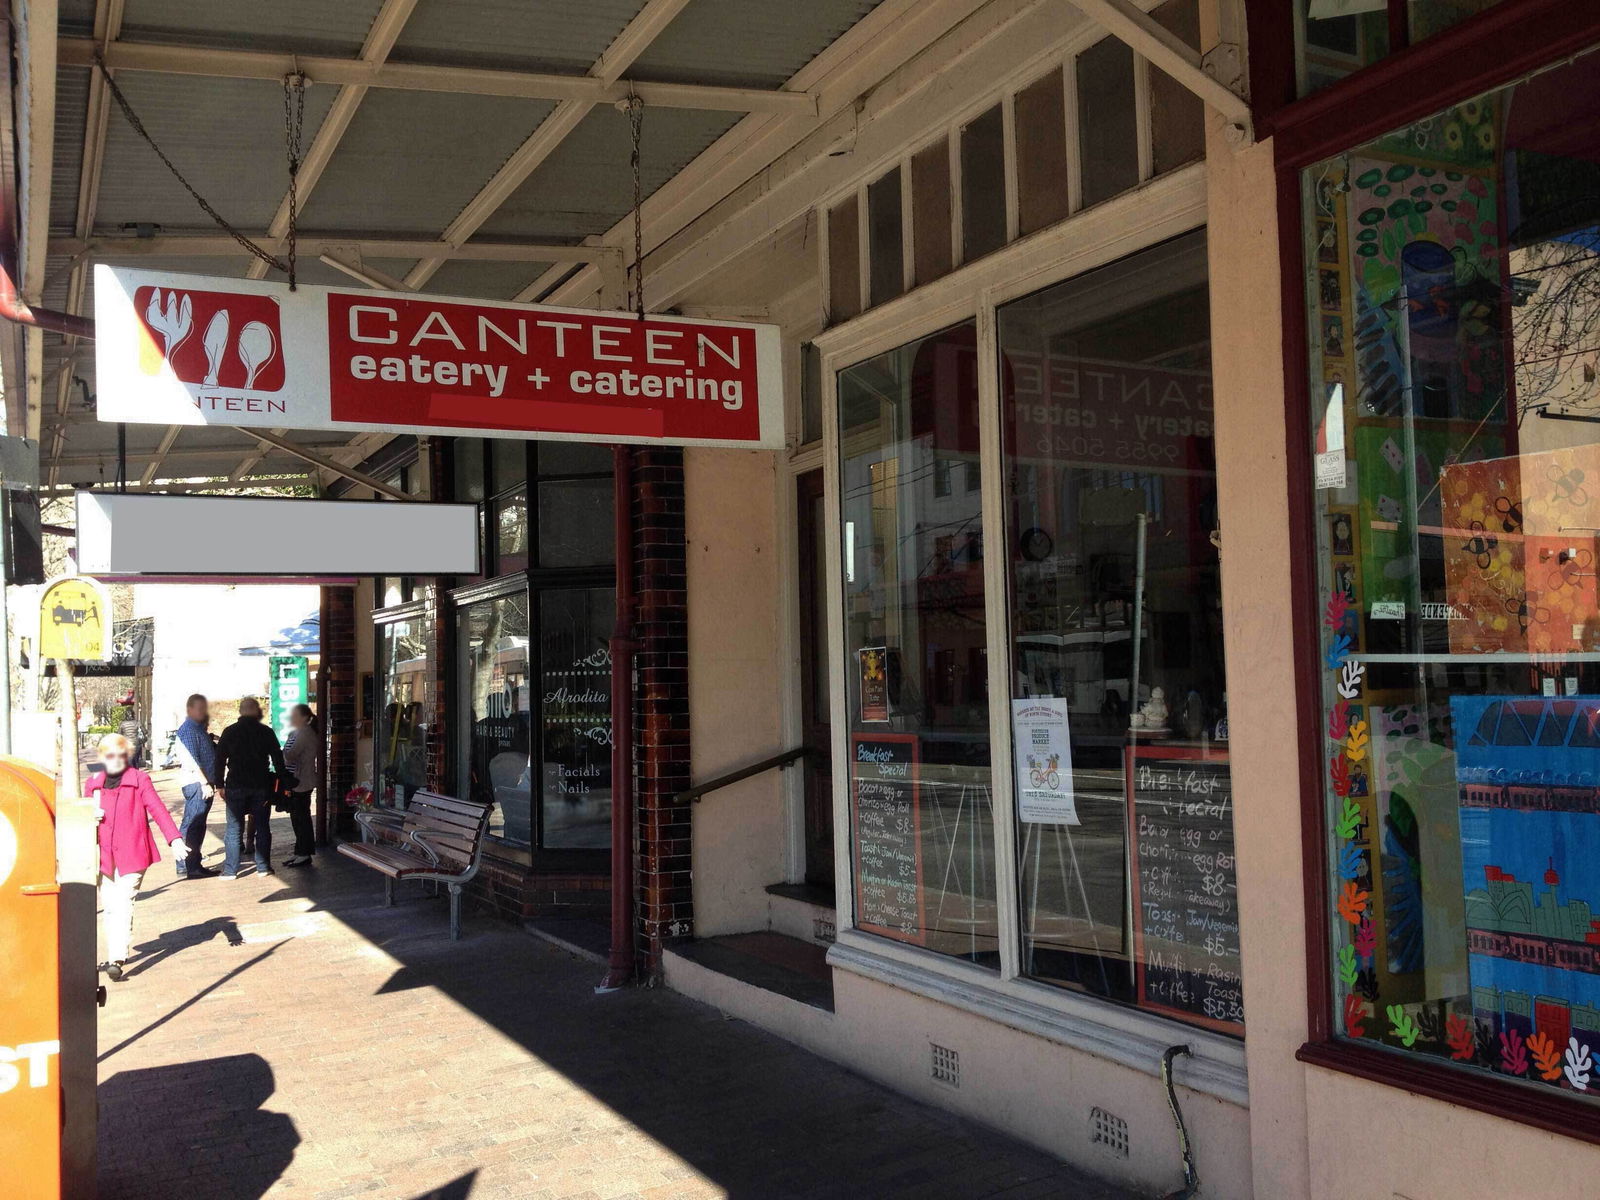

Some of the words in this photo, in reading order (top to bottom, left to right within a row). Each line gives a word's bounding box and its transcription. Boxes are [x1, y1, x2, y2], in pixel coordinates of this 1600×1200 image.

[348, 304, 741, 369] CANTEEN
[350, 354, 509, 398] eatery
[527, 368, 551, 390] +
[569, 368, 744, 411] catering
[193, 396, 287, 413] NTEEN
[543, 687, 609, 709] Afrodita
[857, 744, 894, 766] Breakfast
[557, 763, 601, 777] Facials
[878, 762, 908, 779] Special
[557, 780, 591, 794] Nails
[1163, 796, 1228, 822] pecial
[1192, 854, 1214, 874] egg
[1205, 980, 1241, 1001] Toast
